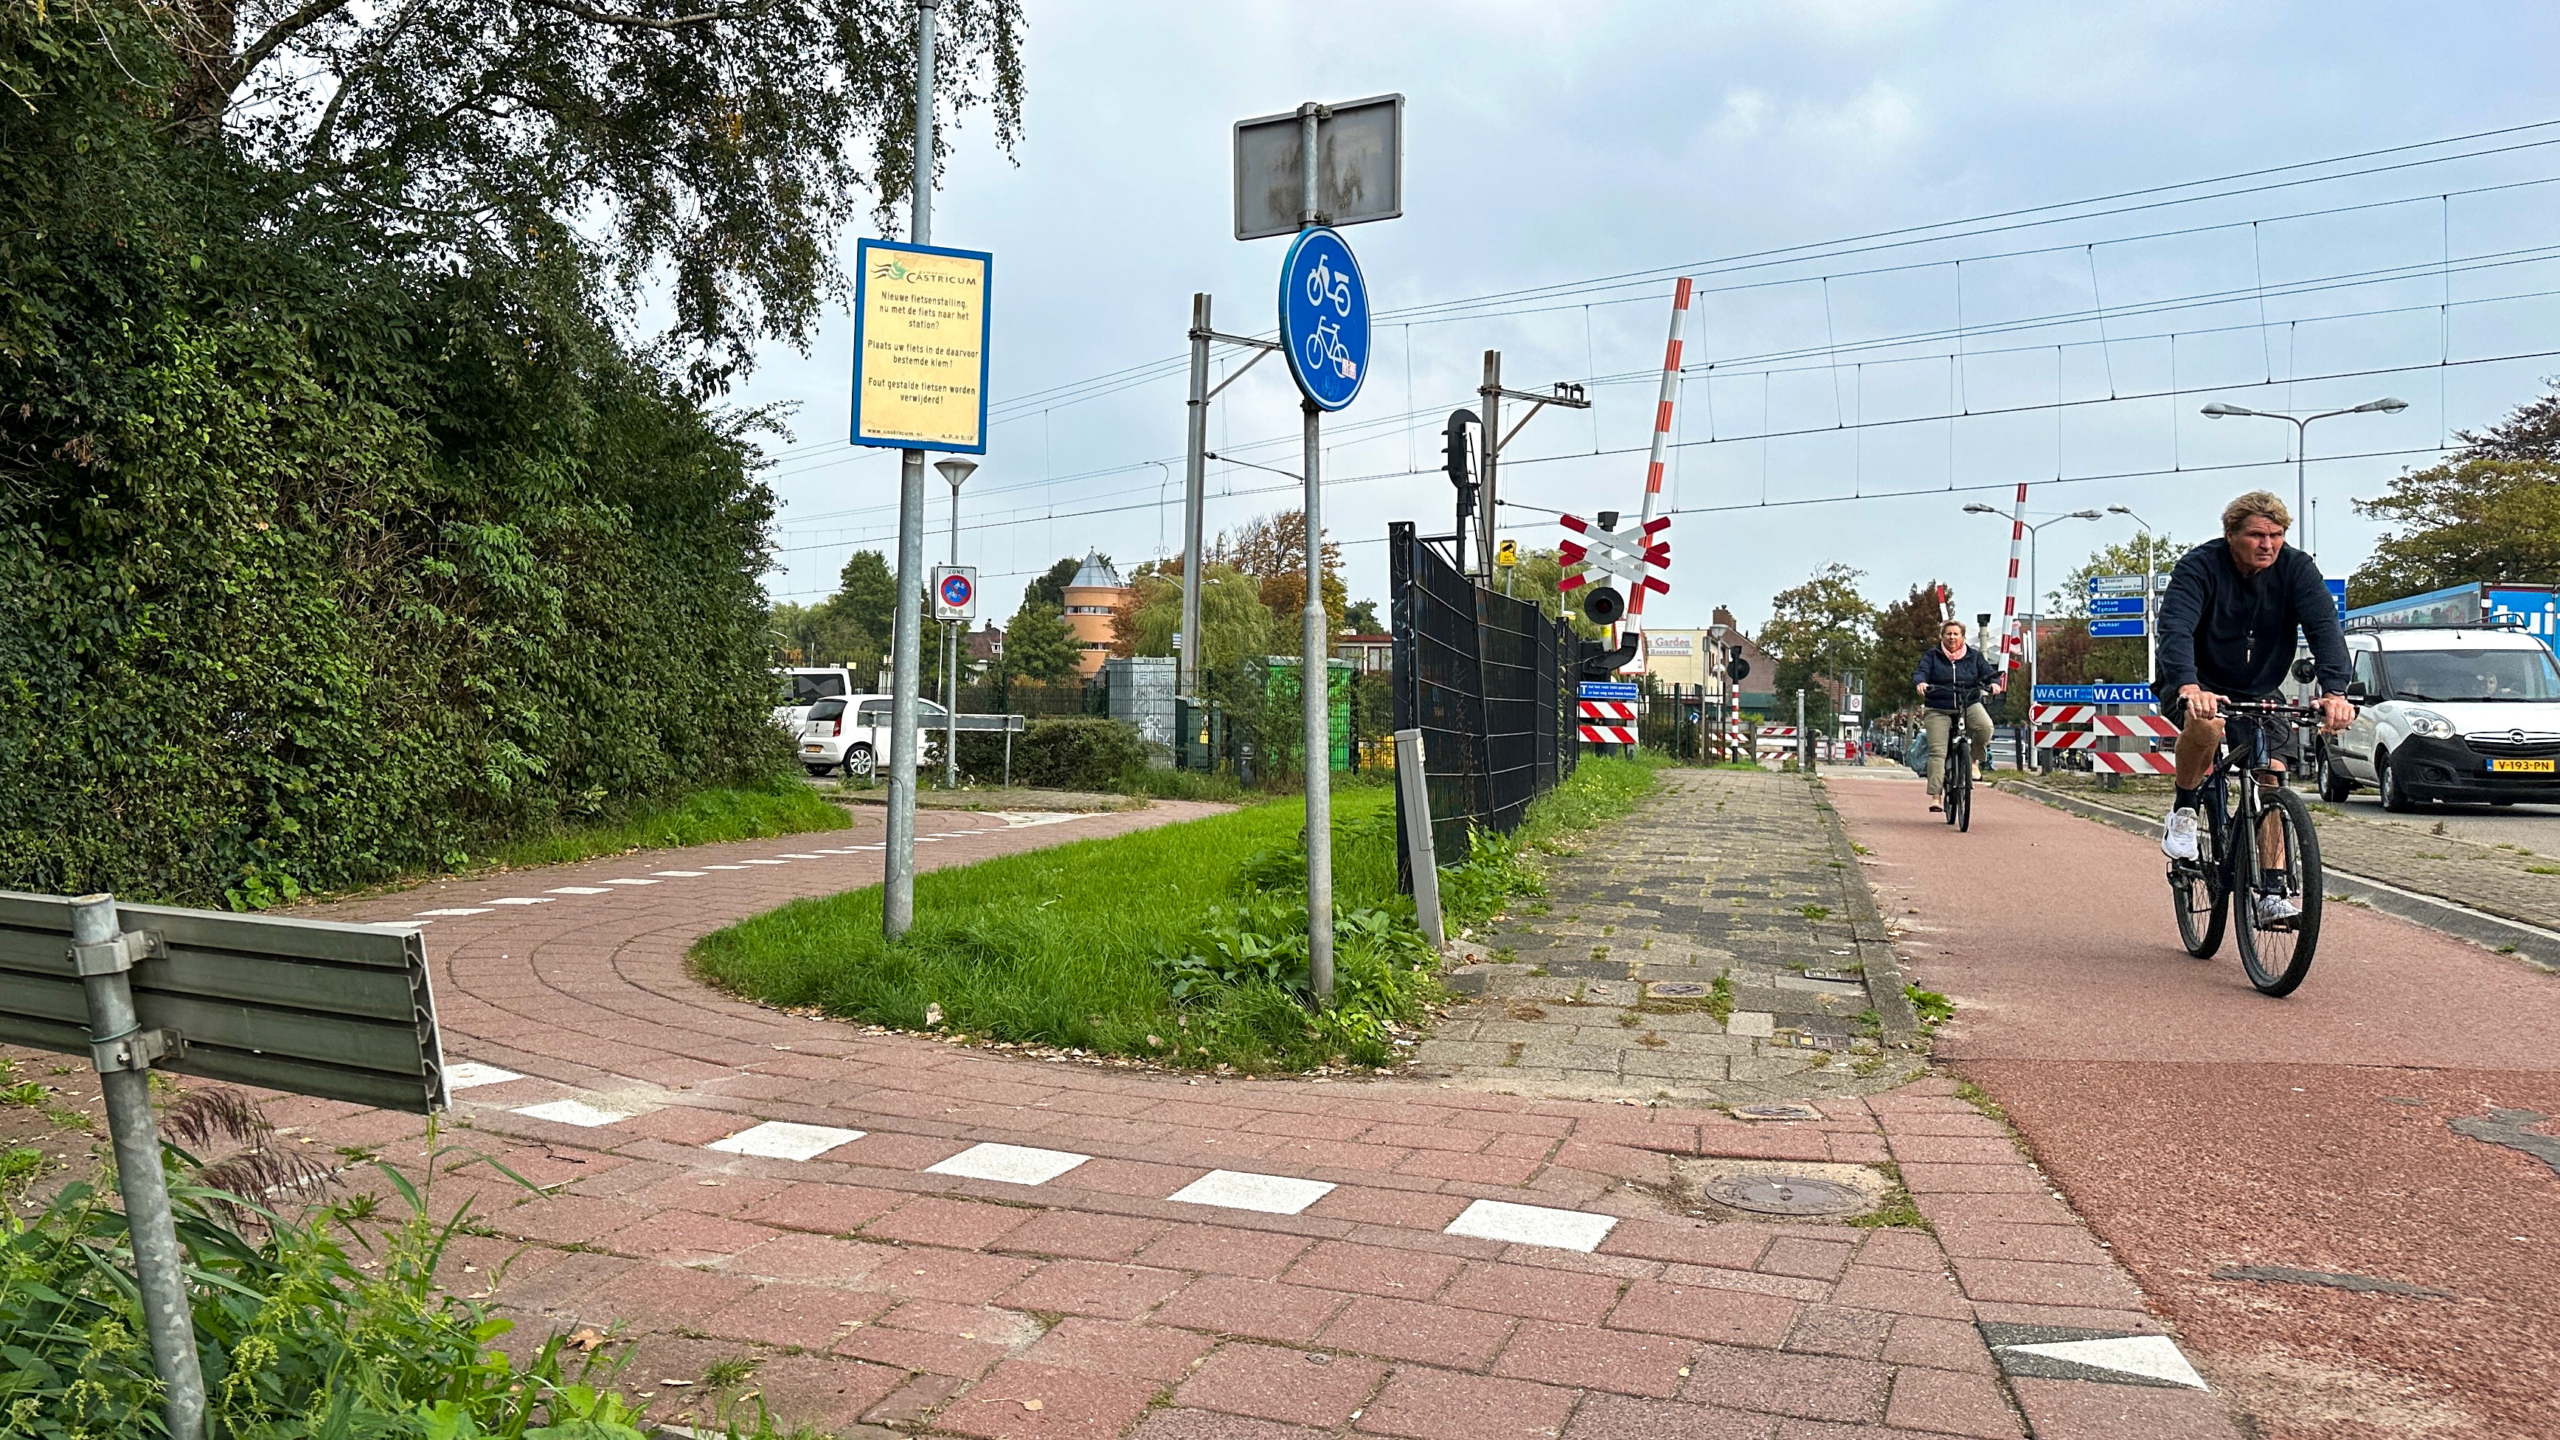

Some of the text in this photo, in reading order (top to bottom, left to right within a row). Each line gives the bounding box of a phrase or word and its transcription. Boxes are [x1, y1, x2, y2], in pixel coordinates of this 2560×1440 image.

[882, 291, 908, 302] Nieuwe
[891, 306, 905, 314] met
[908, 307, 916, 315] de
[919, 308, 935, 317] fiets
[938, 311, 954, 319] naar
[957, 312, 969, 320] het
[909, 320, 940, 330] station?
[868, 340, 978, 358] Plaats uw fiets in de daarvoor
[893, 355, 928, 366] bestemde
[868, 378, 975, 395] Fout gestalde fietsen worden
[900, 394, 943, 405] verwijderd!
[2493, 602, 2560, 634] tui
[1656, 637, 1690, 647] Garden
[2036, 688, 2079, 698] WACHT
[2094, 689, 2153, 700] WACHT
[2498, 761, 2549, 770] V-193-PN
